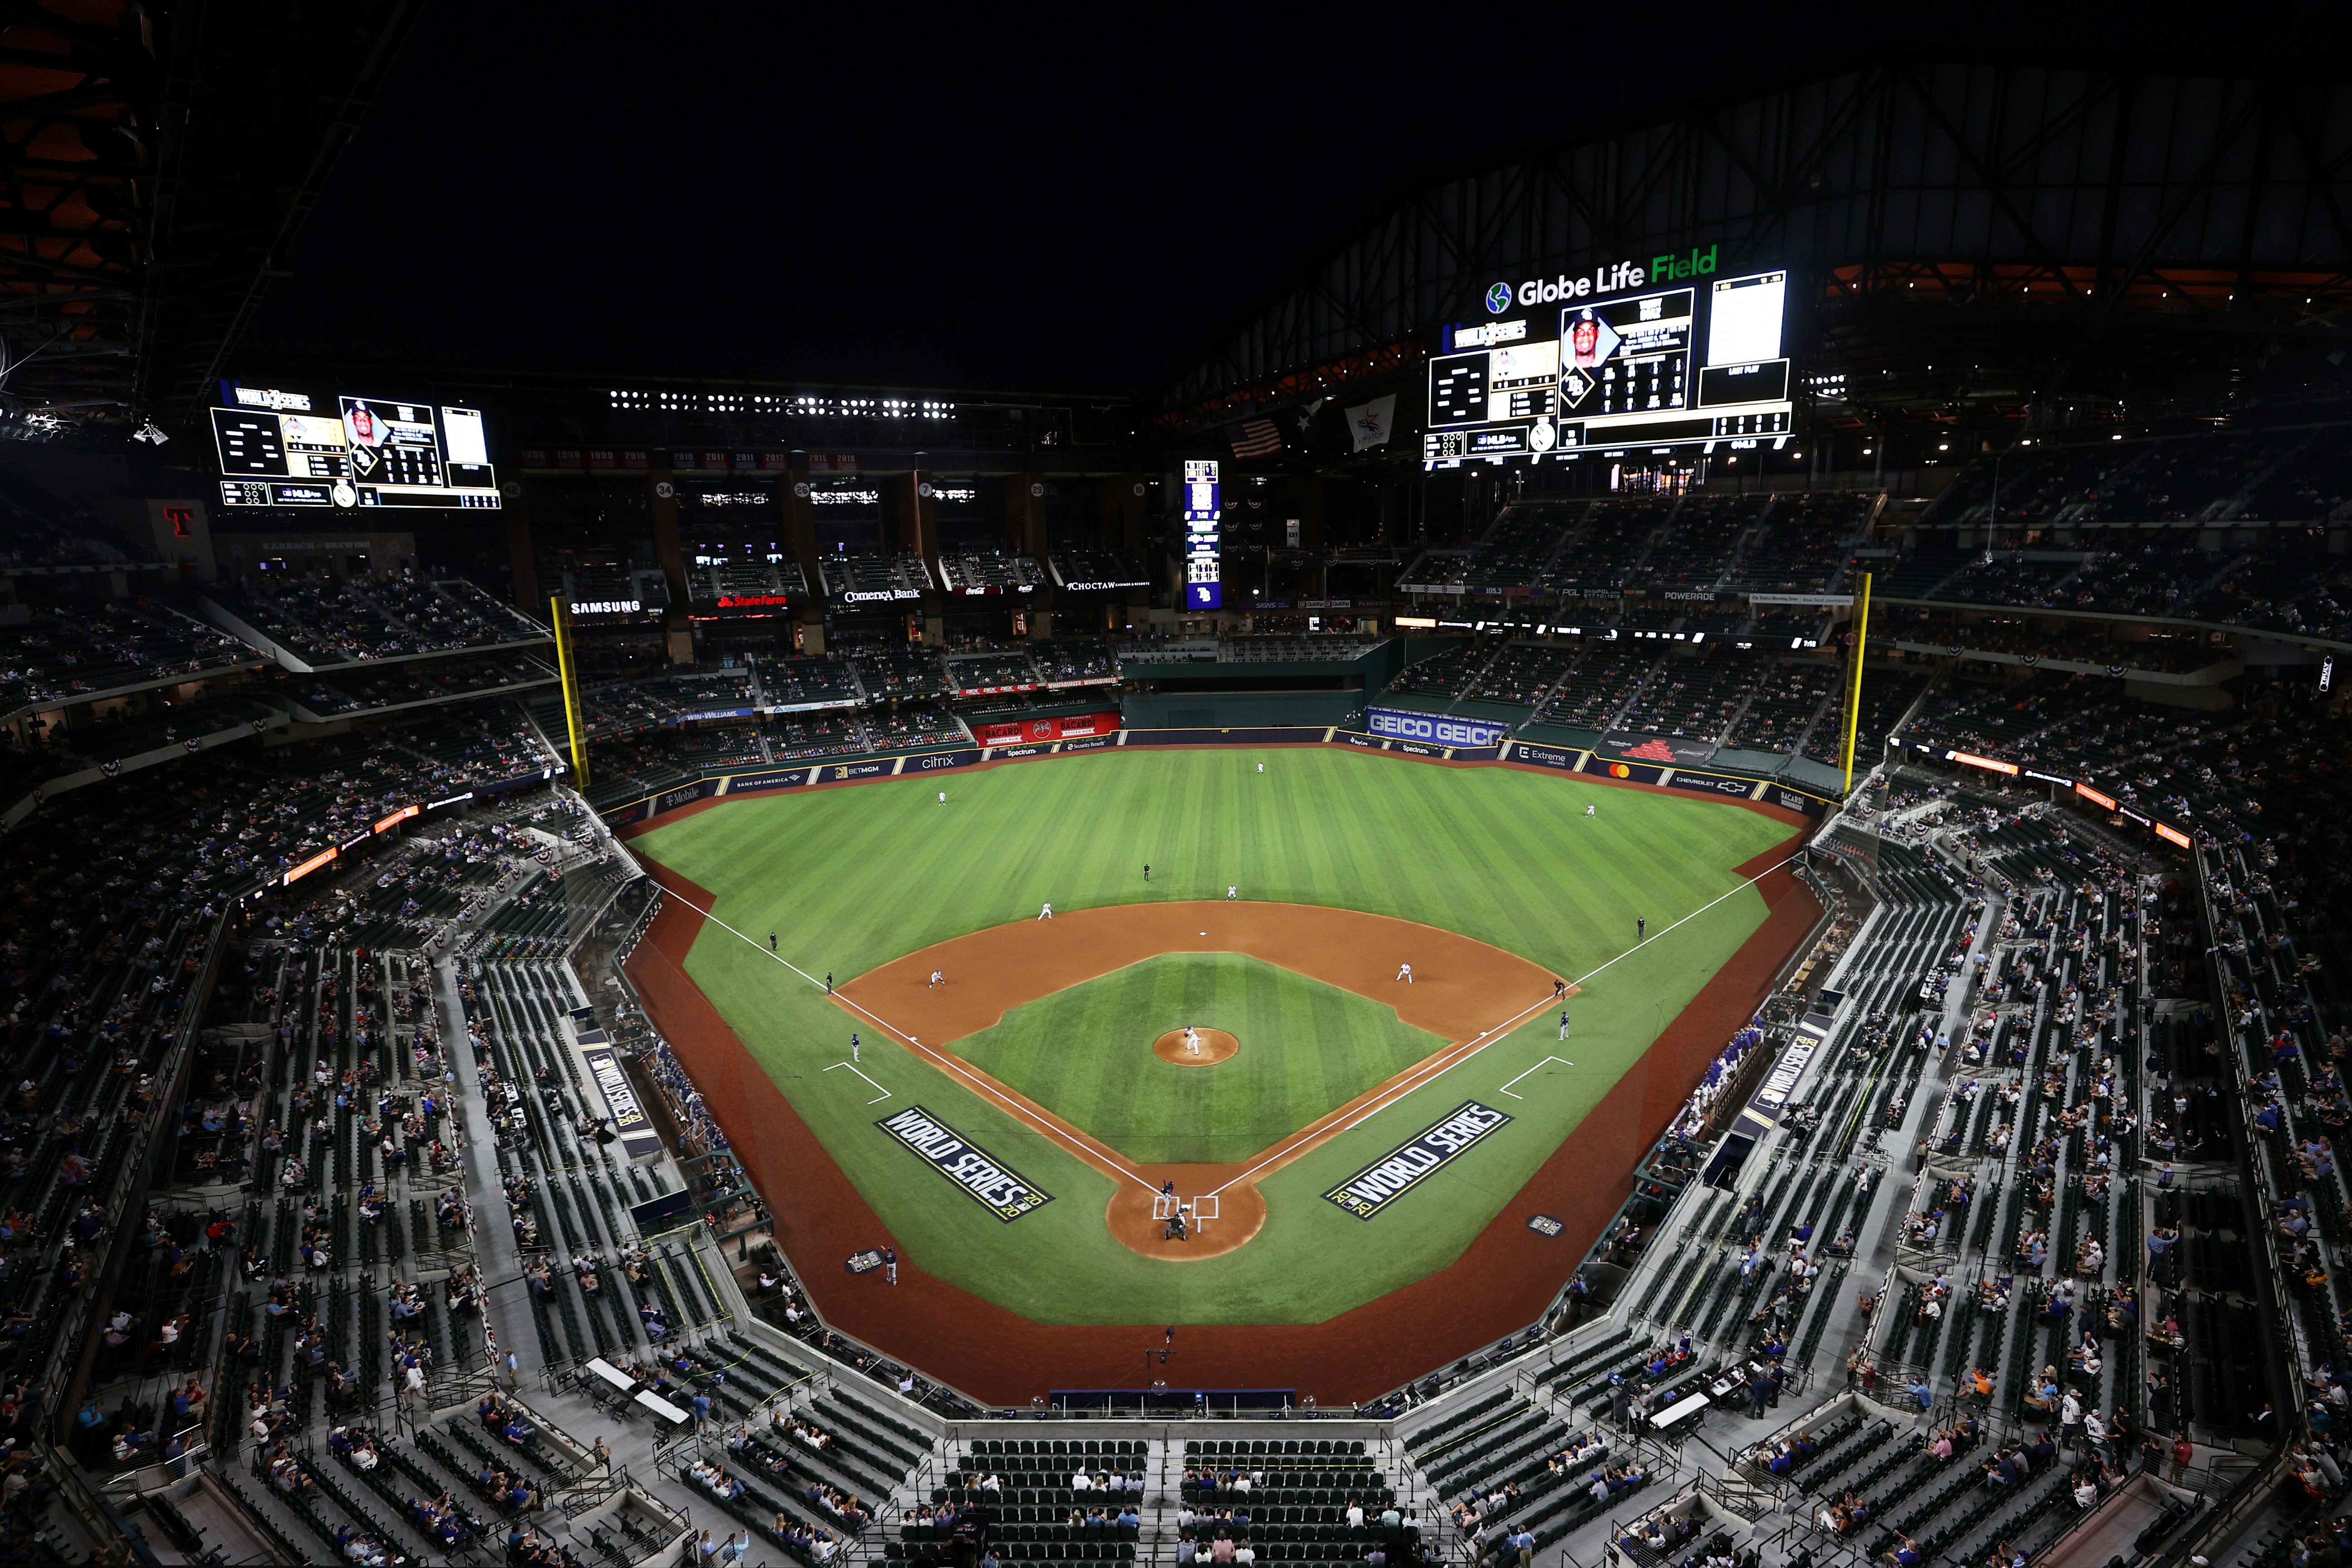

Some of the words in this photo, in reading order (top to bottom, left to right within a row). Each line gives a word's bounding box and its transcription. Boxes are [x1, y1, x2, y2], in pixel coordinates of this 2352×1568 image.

[1518, 274, 1591, 306] Globe
[1596, 261, 1645, 293] Life
[1651, 245, 1717, 283] Field
[1455, 329, 1486, 346] WORLD
[1496, 322, 1526, 339] SERIES
[1729, 367, 1744, 376] LAST
[236, 390, 271, 405] WORLD
[281, 395, 310, 409] SERIES
[1487, 435, 1505, 445] MLB
[292, 489, 310, 498] MLB
[504, 485, 518, 494] 42
[658, 486, 671, 494] 34
[1032, 485, 1042, 494] 29
[165, 507, 193, 537] T
[1072, 582, 1115, 590] CHOCTAW
[894, 589, 920, 599] Bank
[1197, 587, 1210, 602] TB
[1665, 592, 1715, 600] POWERADE
[571, 600, 640, 614] SAMSUNG
[2320, 662, 2329, 685] TRULY
[1048, 681, 1082, 689] WHATABURGER
[1060, 717, 1095, 730] BACARDÍ
[1370, 714, 1432, 737] GEICO
[986, 725, 1022, 737] BACARDÍ
[1403, 745, 1427, 754] Spectrum
[1532, 750, 1566, 762] Extreme
[922, 754, 954, 768] citrix
[849, 766, 879, 774] BETMGM
[1677, 776, 1714, 787] CHEVROLET
[1781, 791, 1805, 805] BACARDÍ
[1765, 1063, 1801, 1093] WORLD
[1784, 1042, 1814, 1068] SERIES
[595, 1065, 627, 1095] WORLD
[608, 1087, 639, 1119] SERIES
[885, 1109, 963, 1159] WORLD
[942, 1153, 1029, 1207] SERIES
[1346, 1146, 1440, 1203] WORLD
[1424, 1104, 1503, 1153] SERIES
[1023, 1194, 1043, 1206] 20
[1331, 1191, 1351, 1204] 20
[1001, 1205, 1021, 1217] 20
[1353, 1202, 1373, 1215] 20
[1530, 1216, 1547, 1229] WORLD
[1545, 1222, 1562, 1236] SERIES
[866, 1251, 881, 1266] WORLD
